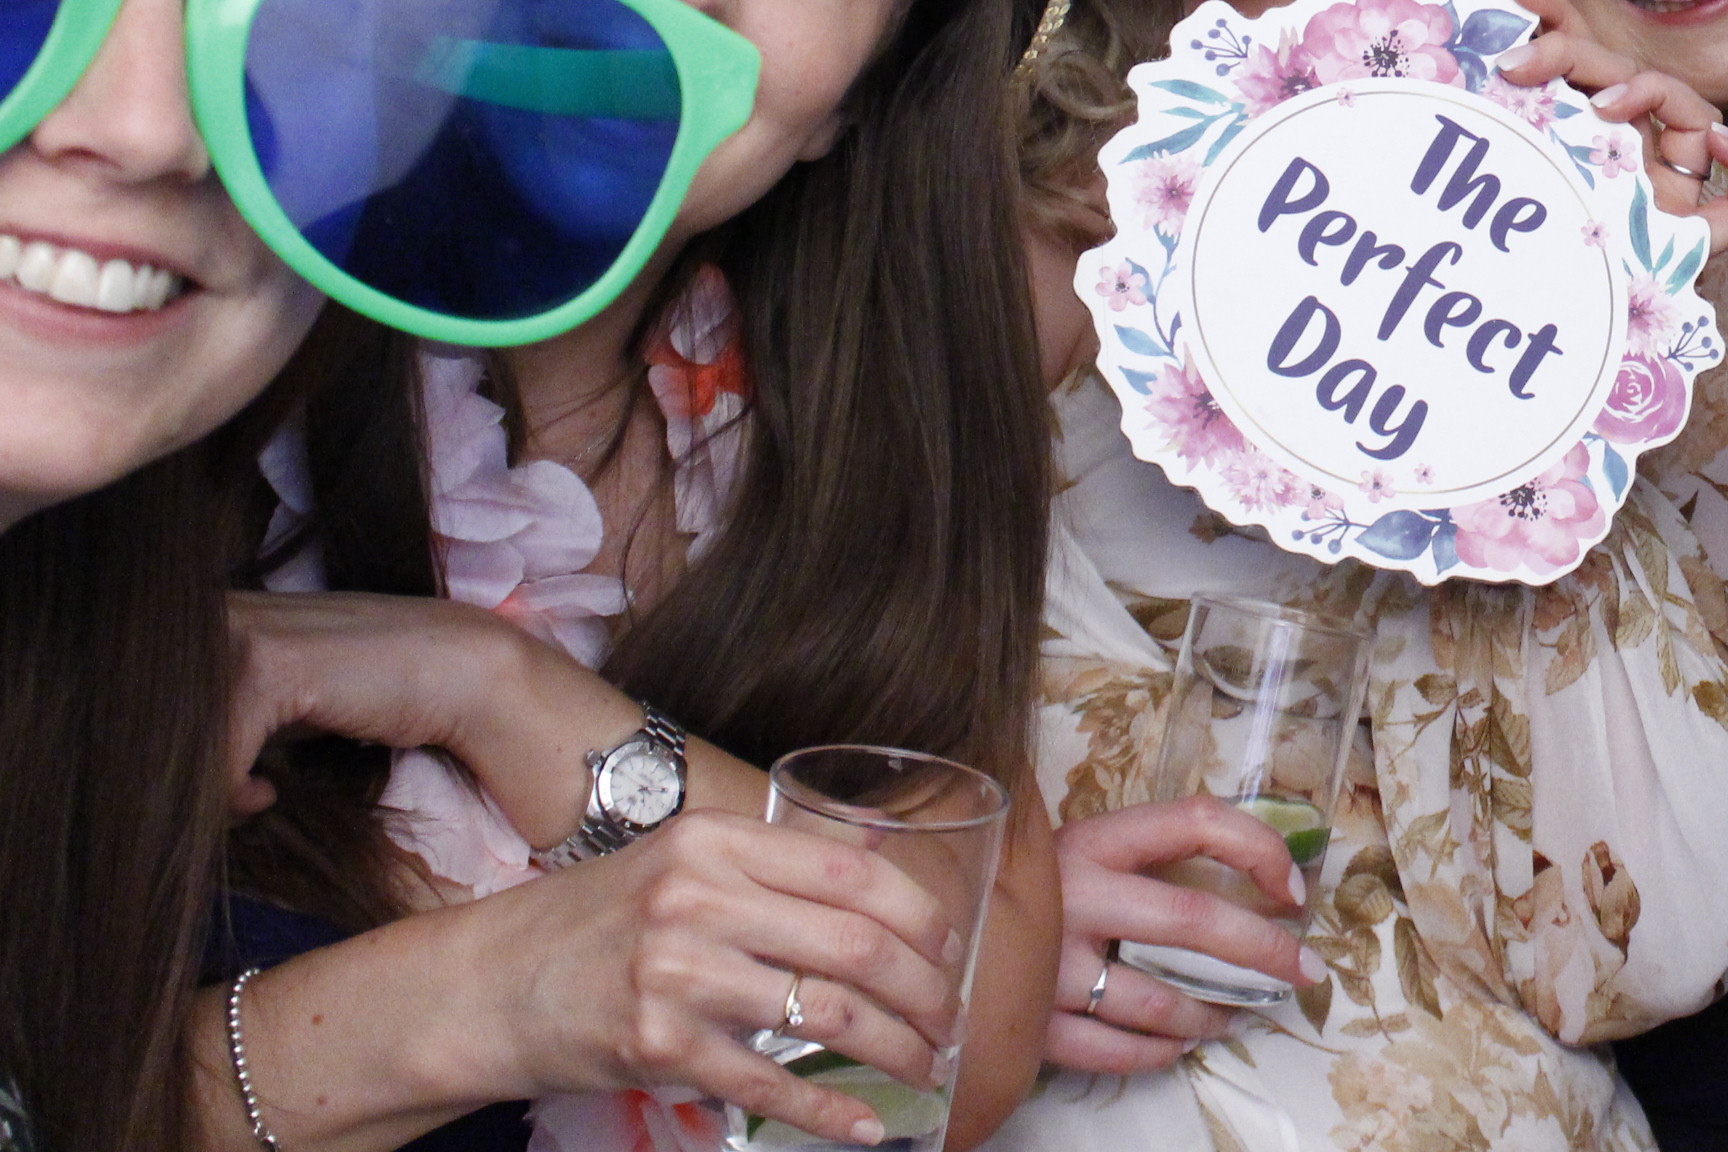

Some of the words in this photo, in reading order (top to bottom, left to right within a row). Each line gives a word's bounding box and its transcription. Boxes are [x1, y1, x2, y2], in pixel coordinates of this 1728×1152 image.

[1410, 114, 1548, 253] The
[1257, 156, 1564, 400] Perfect
[1266, 295, 1429, 461] Day
